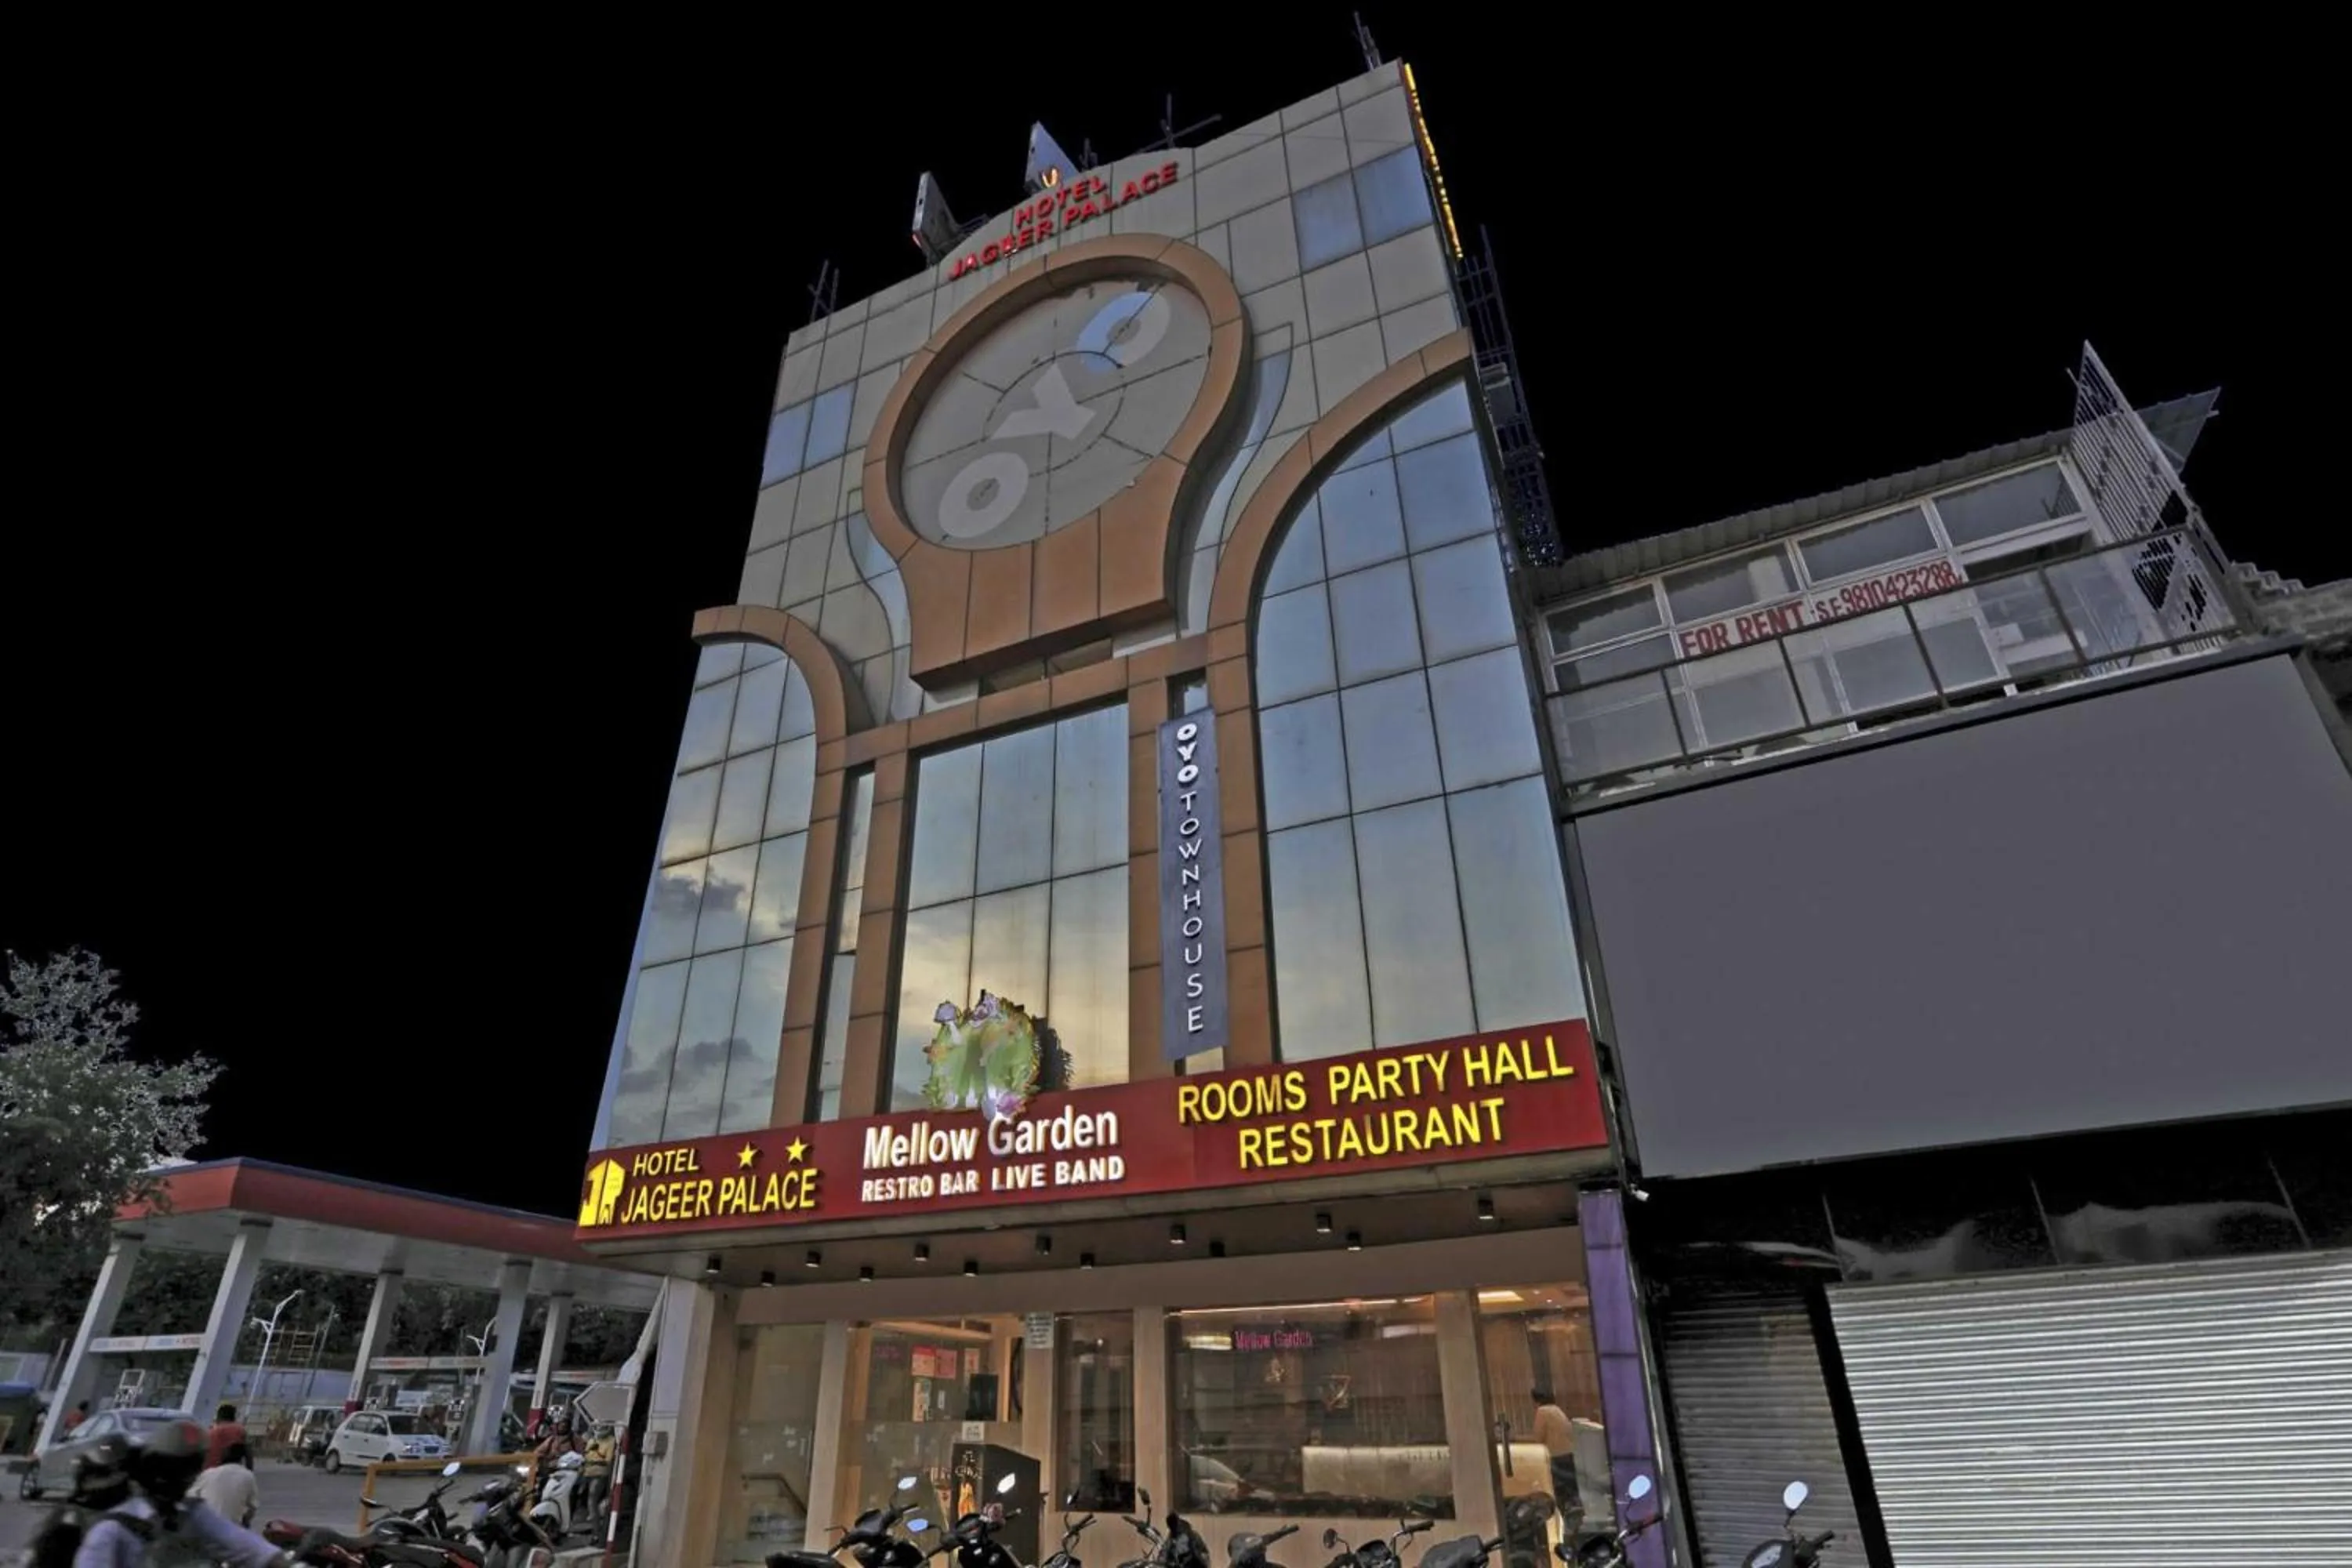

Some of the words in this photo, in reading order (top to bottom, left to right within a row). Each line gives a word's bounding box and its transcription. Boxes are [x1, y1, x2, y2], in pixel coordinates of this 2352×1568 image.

[949, 220, 1054, 281] JAGEER
[1064, 162, 1179, 229] PALACE
[1014, 175, 1108, 227] HOTEL
[939, 289, 1171, 539] OYO
[1679, 622, 1731, 655] FOR
[1735, 601, 1805, 645] RENT
[1177, 723, 1199, 782] OYO
[1178, 792, 1203, 1033] TOWNHOUSE
[1178, 1070, 1307, 1123] ROOMS
[1329, 1050, 1450, 1105] PARTY
[1463, 1035, 1574, 1087] HALL
[633, 1148, 699, 1176] HOTEL
[863, 1121, 979, 1169] Mellow
[988, 1105, 1119, 1155] Garden
[1239, 1098, 1504, 1168] RESTAURANT
[621, 1178, 713, 1223] JAGEER
[718, 1168, 818, 1214] PALACE
[862, 1174, 934, 1202] RESTRO
[940, 1170, 979, 1196] BAR
[992, 1163, 1047, 1191] LIVE
[1055, 1155, 1125, 1185] BAND
